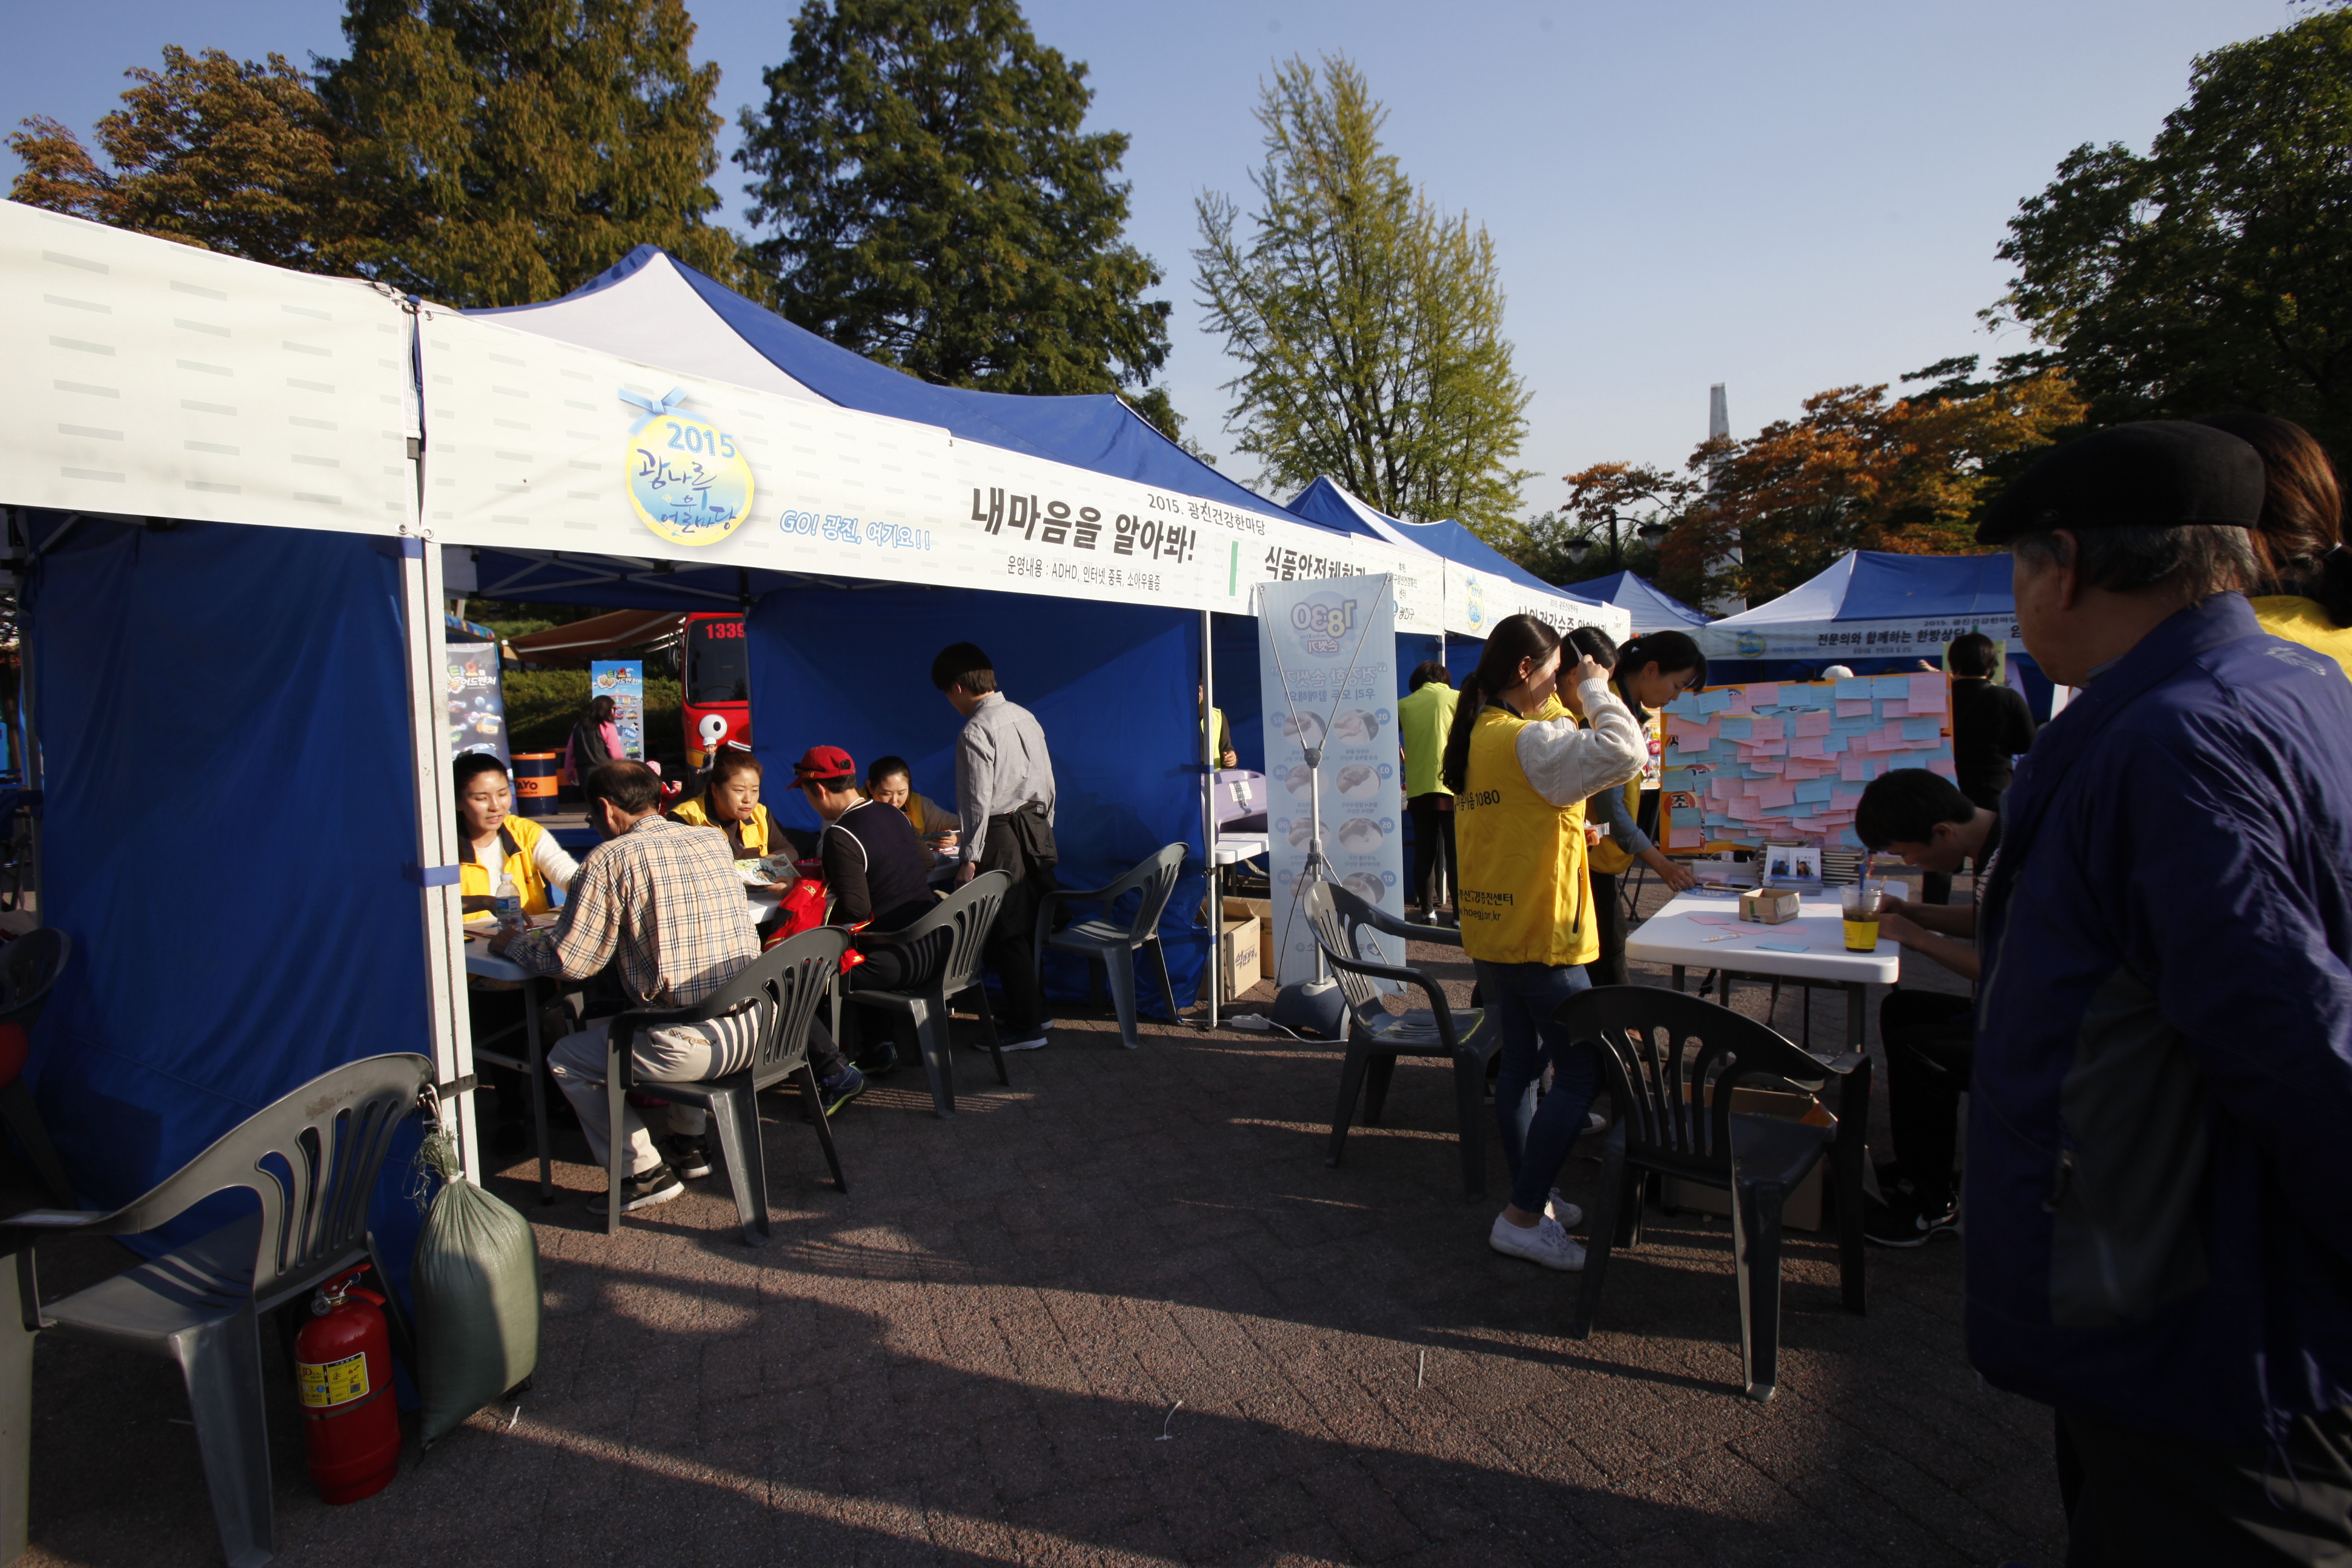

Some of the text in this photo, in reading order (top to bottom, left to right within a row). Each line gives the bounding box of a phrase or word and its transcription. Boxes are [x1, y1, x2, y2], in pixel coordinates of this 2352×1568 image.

[666, 421, 736, 458] 2015
[1147, 493, 1265, 536] 2015. 광진건강한마당
[779, 510, 819, 536] GO!
[822, 514, 862, 545] 광진,
[971, 487, 1196, 564] 내마음을 알아봐!
[1008, 556, 1042, 578] 운영내용
[1051, 563, 1080, 582] ADHD,
[1083, 565, 1106, 585] 인터넷
[1108, 569, 1124, 587] 중독,
[1127, 571, 1160, 591] 소아우울증
[1399, 589, 1406, 599] 센터
[1399, 607, 1415, 620] 광진구
[706, 623, 745, 639] 1339
[1818, 631, 1861, 646] 전문의와
[1867, 629, 1912, 644] 함께하는
[461, 676, 496, 686] 어드벤처
[1475, 790, 1501, 806] 1080
